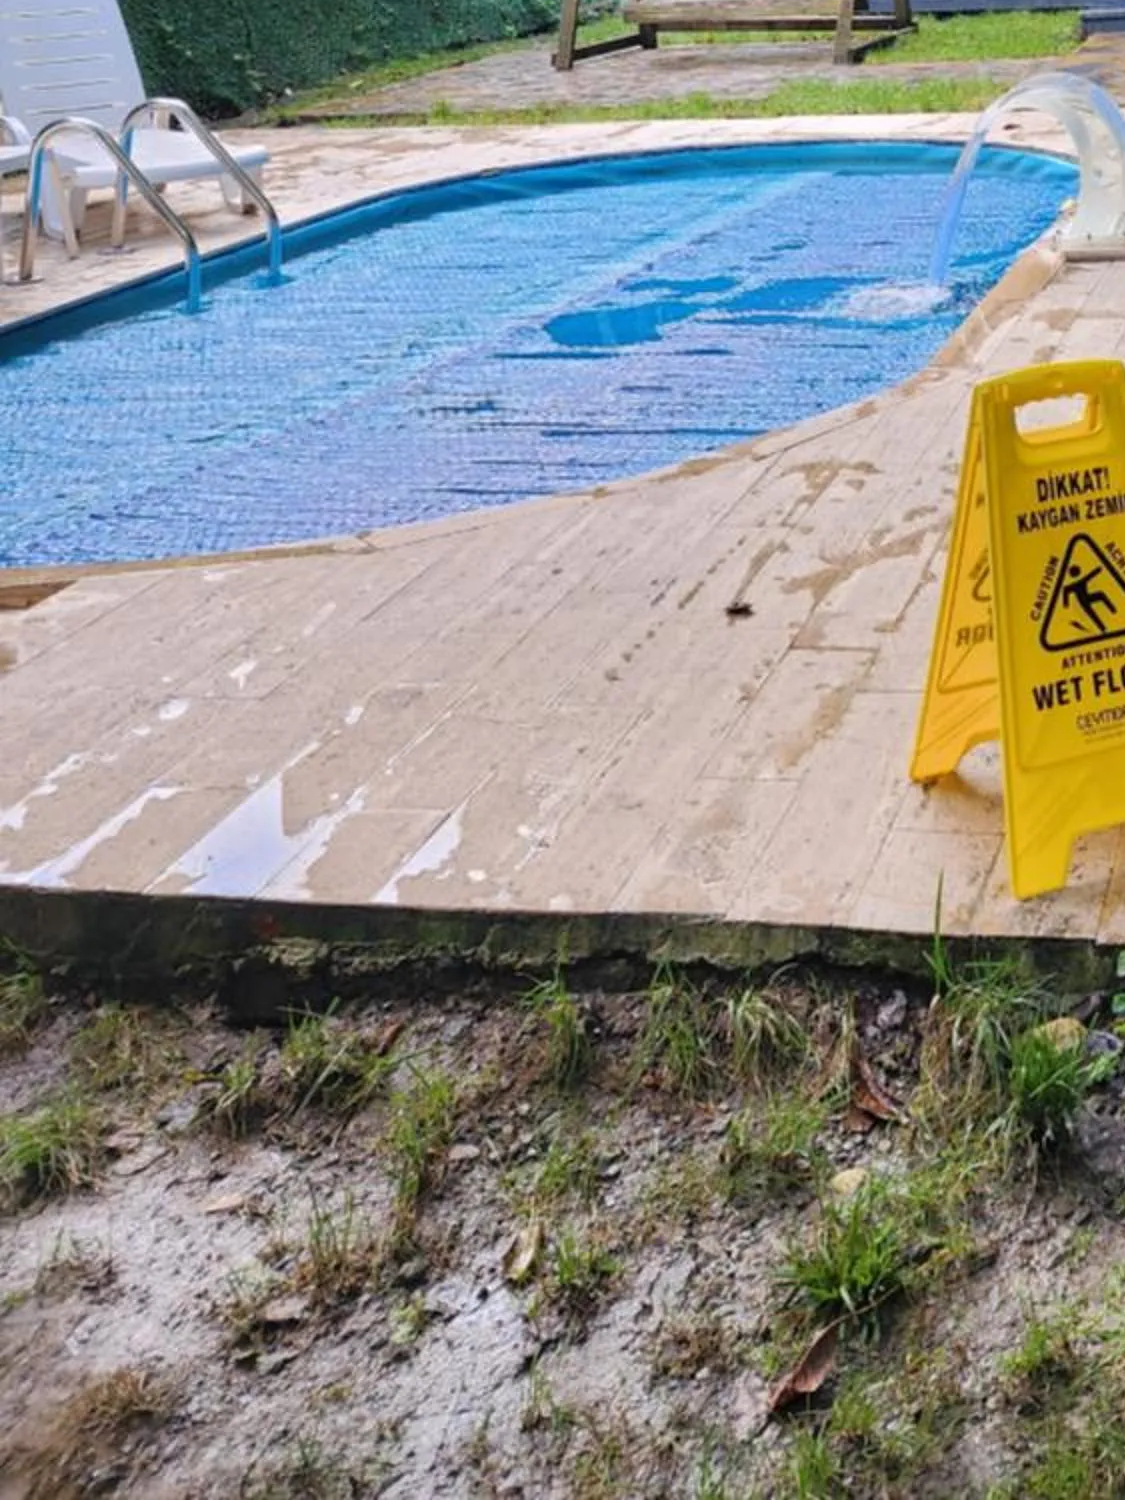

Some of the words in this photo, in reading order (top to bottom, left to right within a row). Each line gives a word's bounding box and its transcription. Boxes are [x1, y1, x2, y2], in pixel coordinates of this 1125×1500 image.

[1036, 466, 1111, 503] DİKKAT!
[1016, 504, 1081, 535] KAYGAN
[1029, 555, 1059, 622] CAUTION
[1032, 675, 1083, 711] WET
